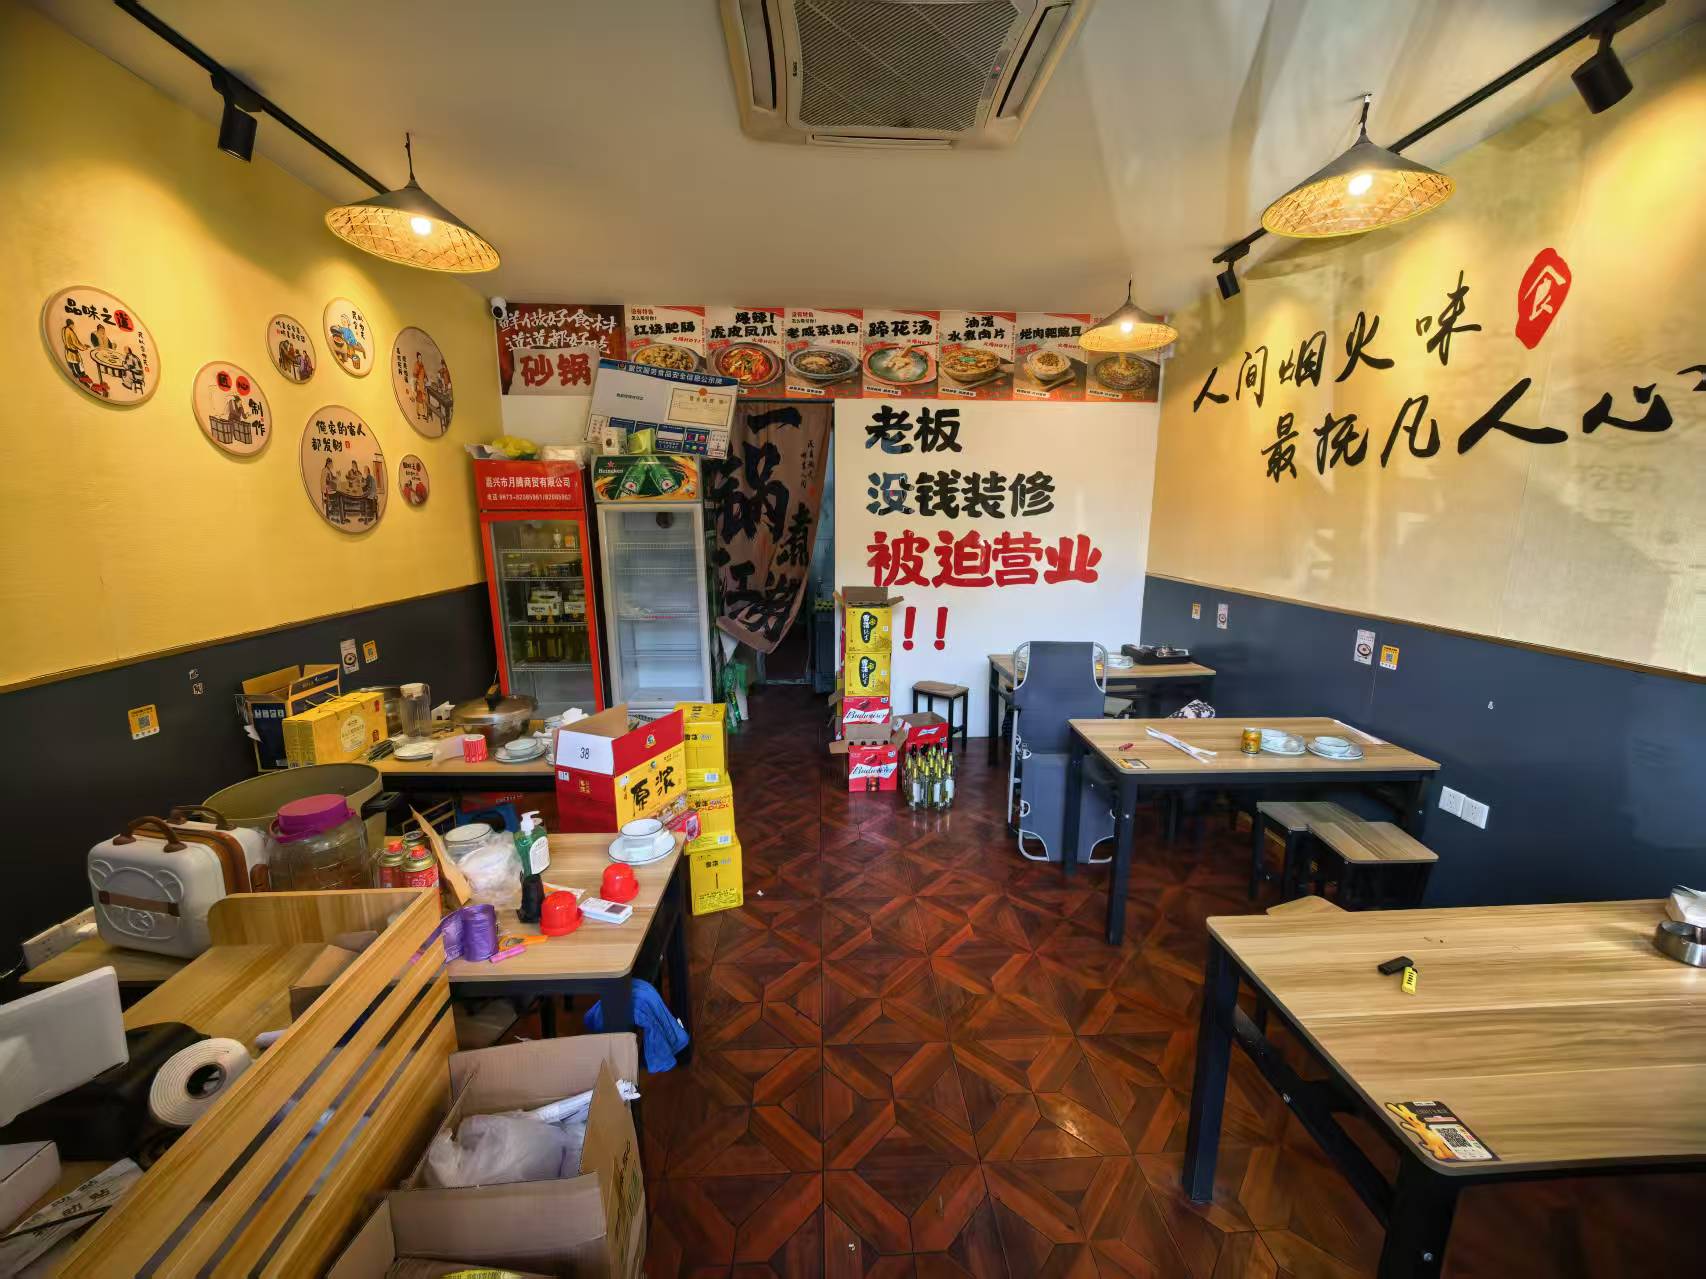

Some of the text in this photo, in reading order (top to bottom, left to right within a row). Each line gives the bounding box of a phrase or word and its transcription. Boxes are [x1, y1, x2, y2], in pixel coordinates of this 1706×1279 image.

[64, 297, 134, 332] 品味之道
[633, 321, 696, 336] 红烧肥肠
[710, 325, 777, 339] 虎皮凤爪
[786, 323, 859, 339] 老咸菜烧白
[868, 319, 933, 338] 蹄花汤
[947, 327, 1006, 342] 水煮肉片
[1193, 269, 1483, 414] 人间烟火味
[520, 353, 592, 387] 砂锅
[864, 405, 963, 454] 老板
[1260, 377, 1673, 484] 最抚凡人心
[866, 469, 1056, 519] 没钱装修
[866, 529, 1103, 588] 被迫营业
[846, 706, 886, 721] Budweiser
[580, 747, 590, 760] 38
